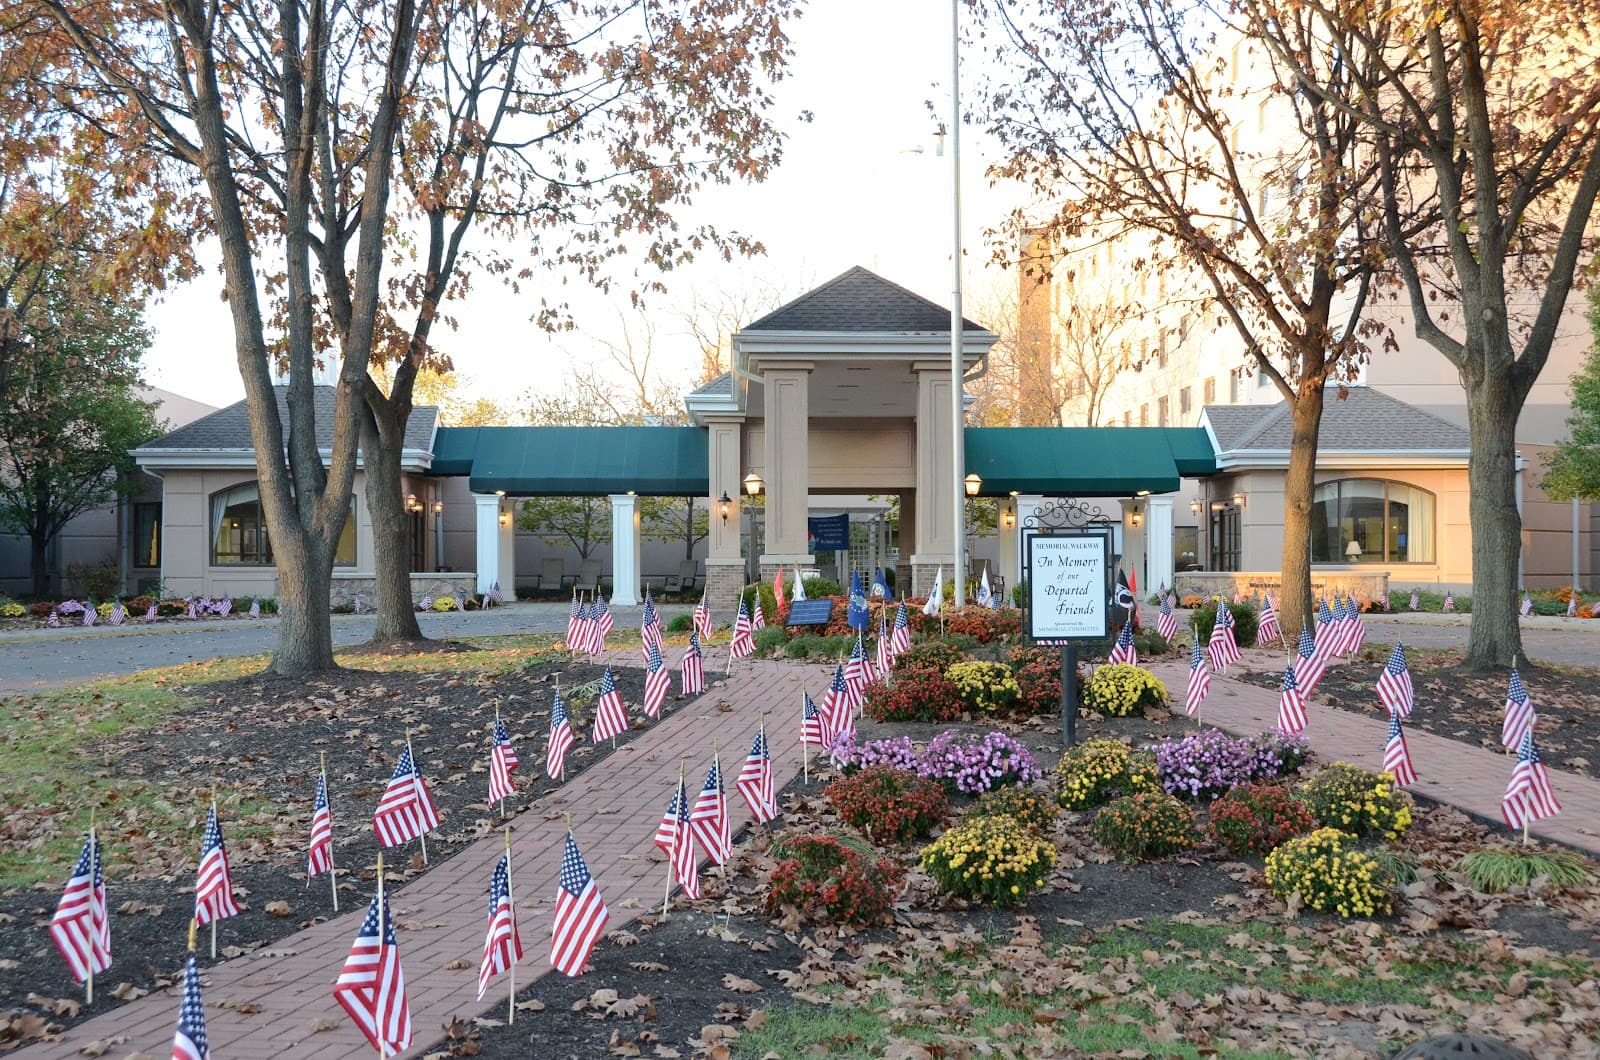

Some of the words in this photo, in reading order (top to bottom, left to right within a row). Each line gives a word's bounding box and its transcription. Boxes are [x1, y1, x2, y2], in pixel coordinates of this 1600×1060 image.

[1038, 556, 1052, 567] In
[1058, 555, 1098, 573] Memory
[1057, 570, 1064, 583] of
[1045, 581, 1093, 601] Departed
[1056, 600, 1095, 615] Friends
